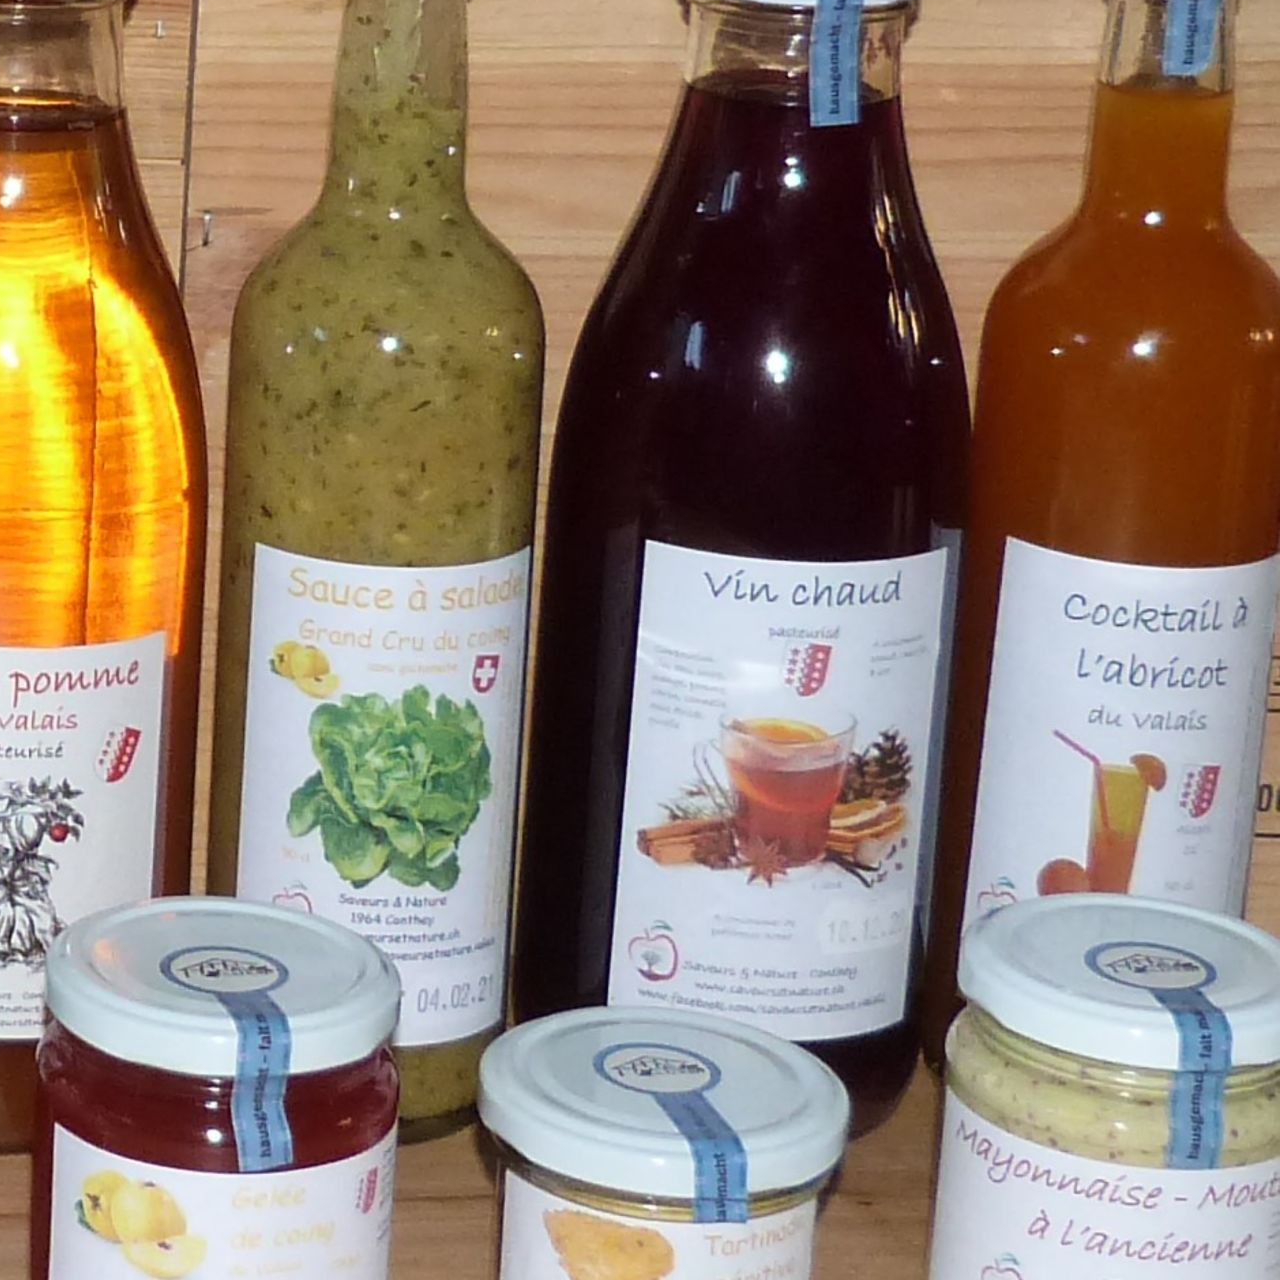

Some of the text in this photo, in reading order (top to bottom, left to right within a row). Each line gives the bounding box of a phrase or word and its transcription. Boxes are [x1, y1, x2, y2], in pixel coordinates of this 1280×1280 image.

[828, 24, 848, 115] hausgemacht
[288, 566, 395, 611] Sauce
[408, 579, 428, 612] à
[704, 570, 902, 607] Vin chaud
[1064, 593, 1248, 632] Cocktail à
[299, 619, 372, 650] Grand
[383, 629, 424, 651] Cru
[434, 628, 459, 651] du
[9, 658, 140, 708] pomme
[1077, 648, 1228, 689] l'abricot
[1088, 705, 1124, 726] du
[1200, 1032, 1212, 1059] fait
[955, 1120, 1162, 1209] Mayonnaise
[1028, 1209, 1253, 1264] à l'ancienne
